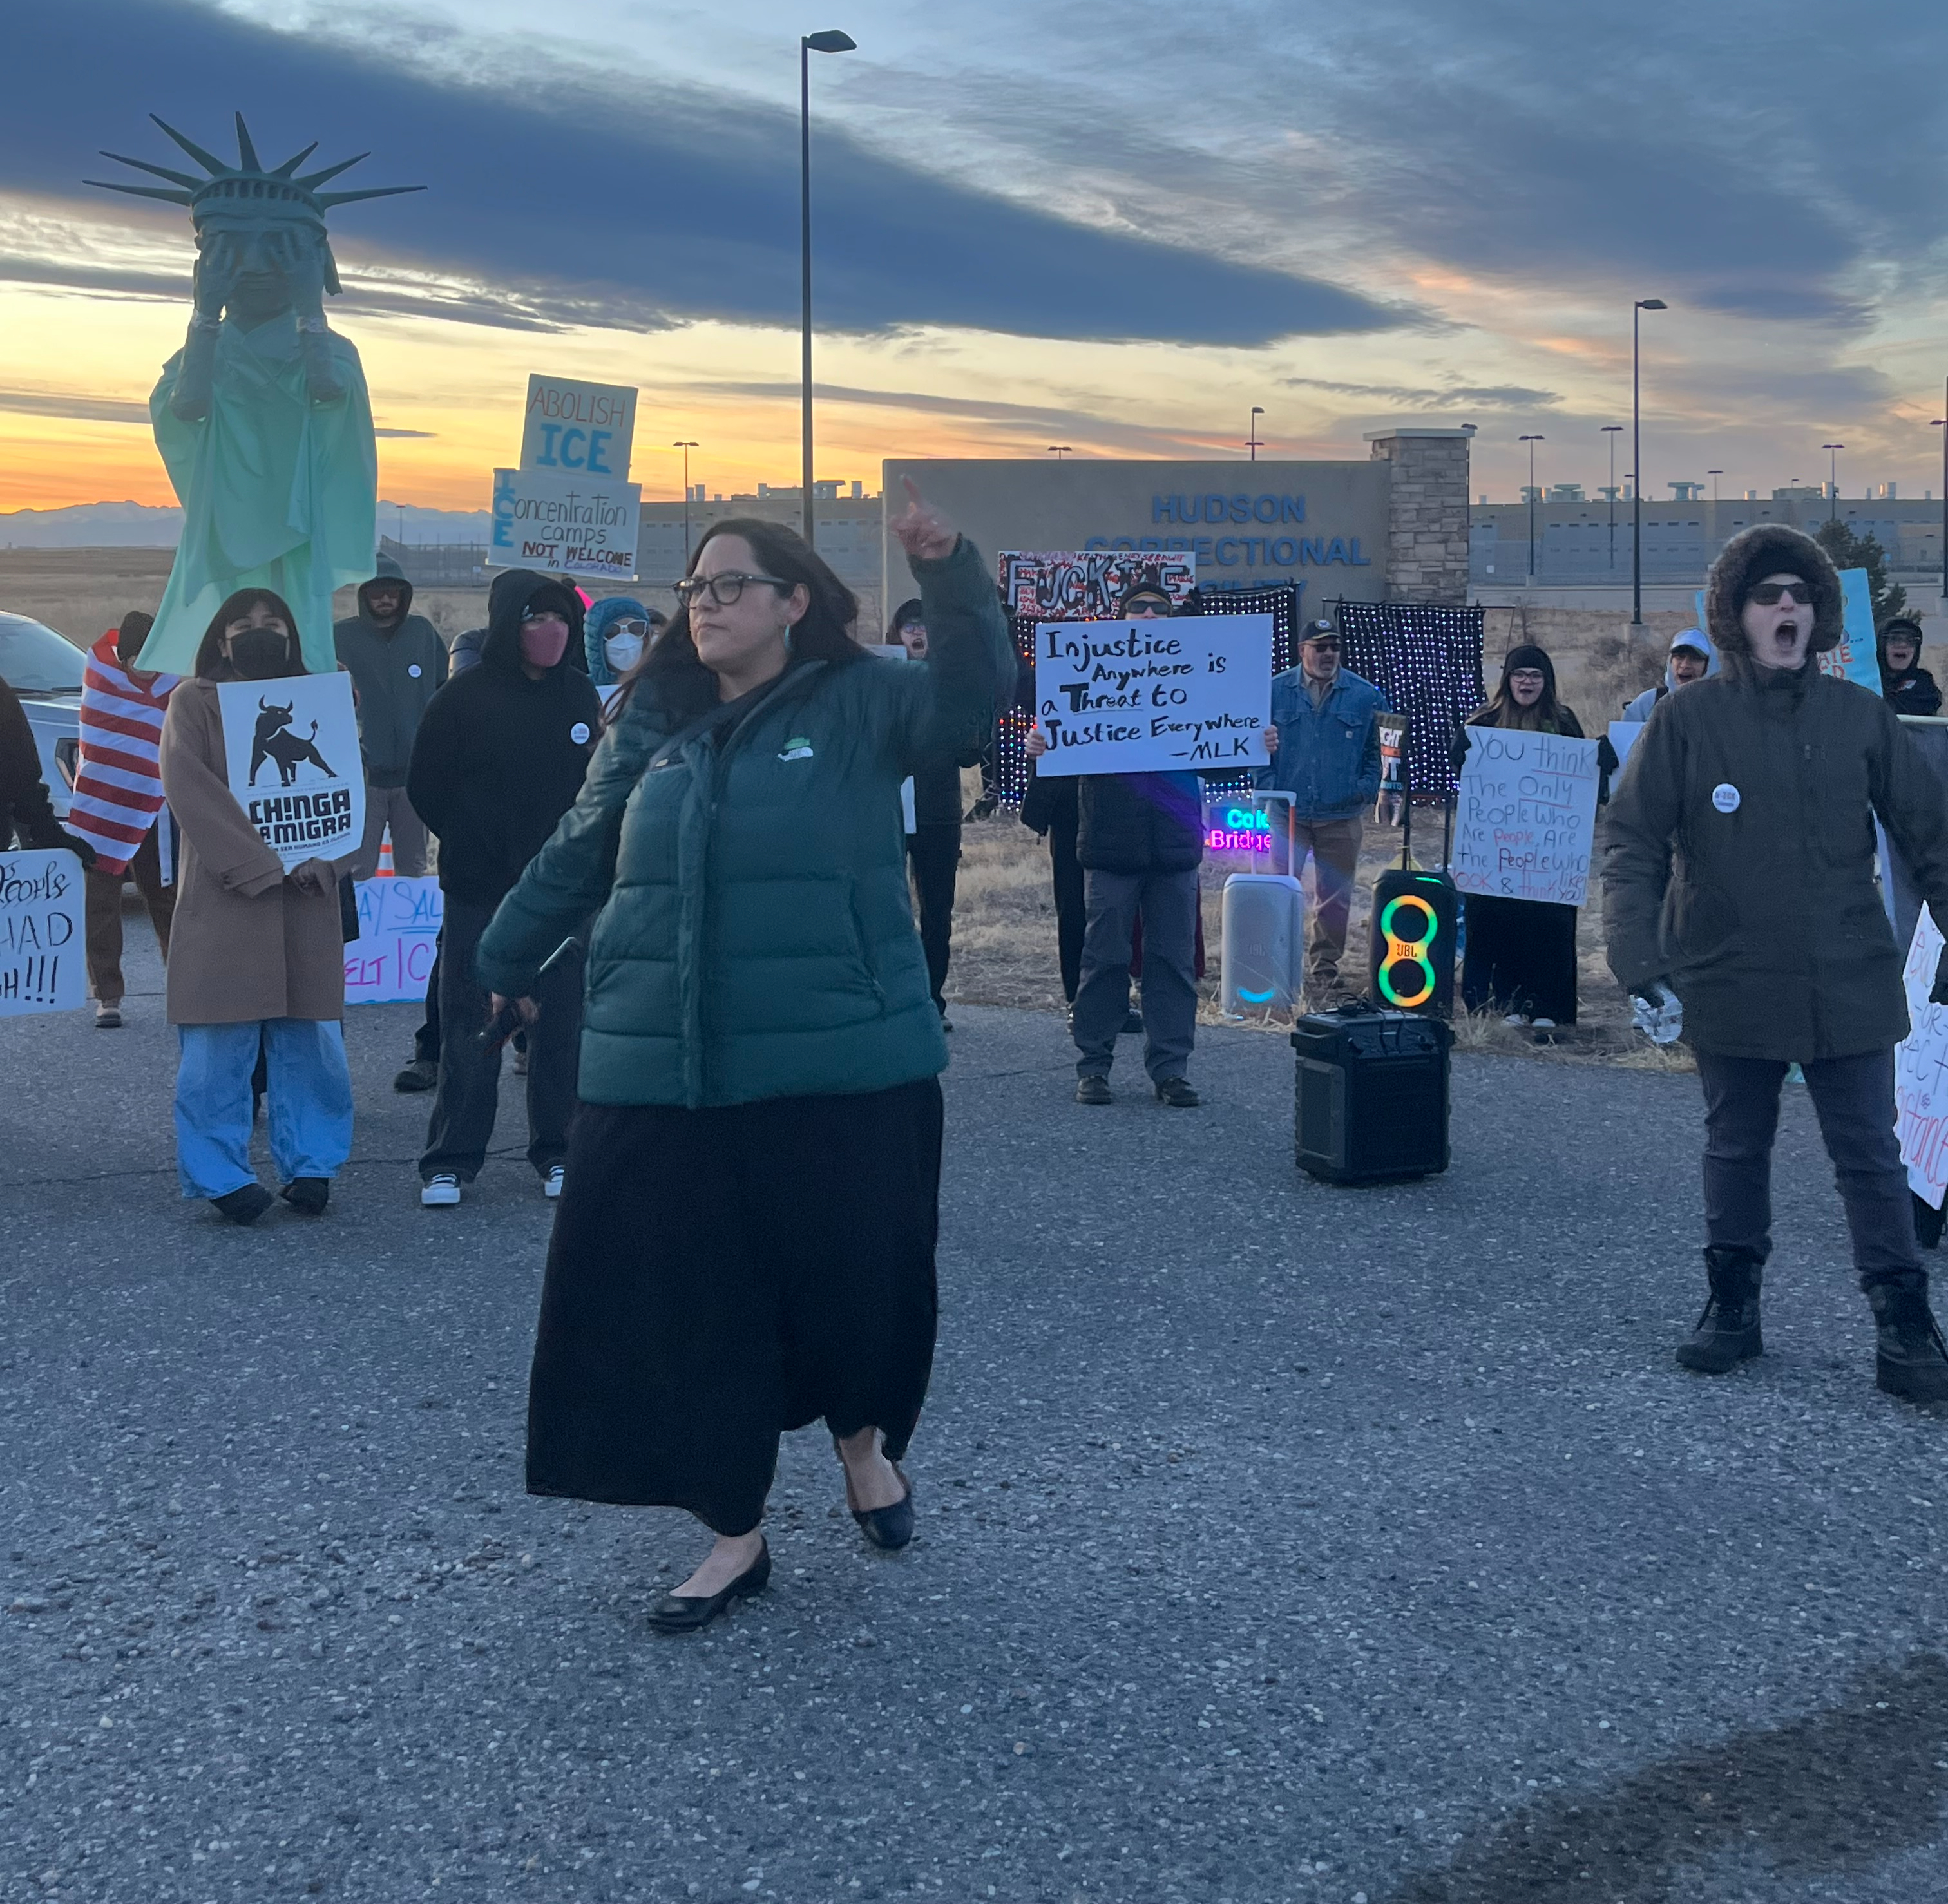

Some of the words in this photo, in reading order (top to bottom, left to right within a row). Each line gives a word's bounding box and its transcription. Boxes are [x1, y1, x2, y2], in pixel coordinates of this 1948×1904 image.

[528, 386, 626, 428] ABOLISH
[536, 423, 612, 474] ICE
[1152, 494, 1306, 523] HUDSON
[541, 525, 607, 547] camps
[522, 541, 559, 559] NOT
[566, 546, 633, 567] WELCOME
[548, 559, 559, 569] in
[1114, 560, 1190, 598] IE
[1046, 628, 1183, 672] Injustice
[1091, 660, 1194, 691] Anywhere
[1208, 652, 1227, 674] is
[1041, 699, 1058, 716] a
[1060, 683, 1143, 713] Threat
[1152, 684, 1187, 707] to
[1045, 719, 1142, 750] Justice
[1532, 736, 1594, 774] think
[1461, 774, 1507, 799] The
[1462, 823, 1485, 842] Are
[1396, 943, 1418, 958] JBL
